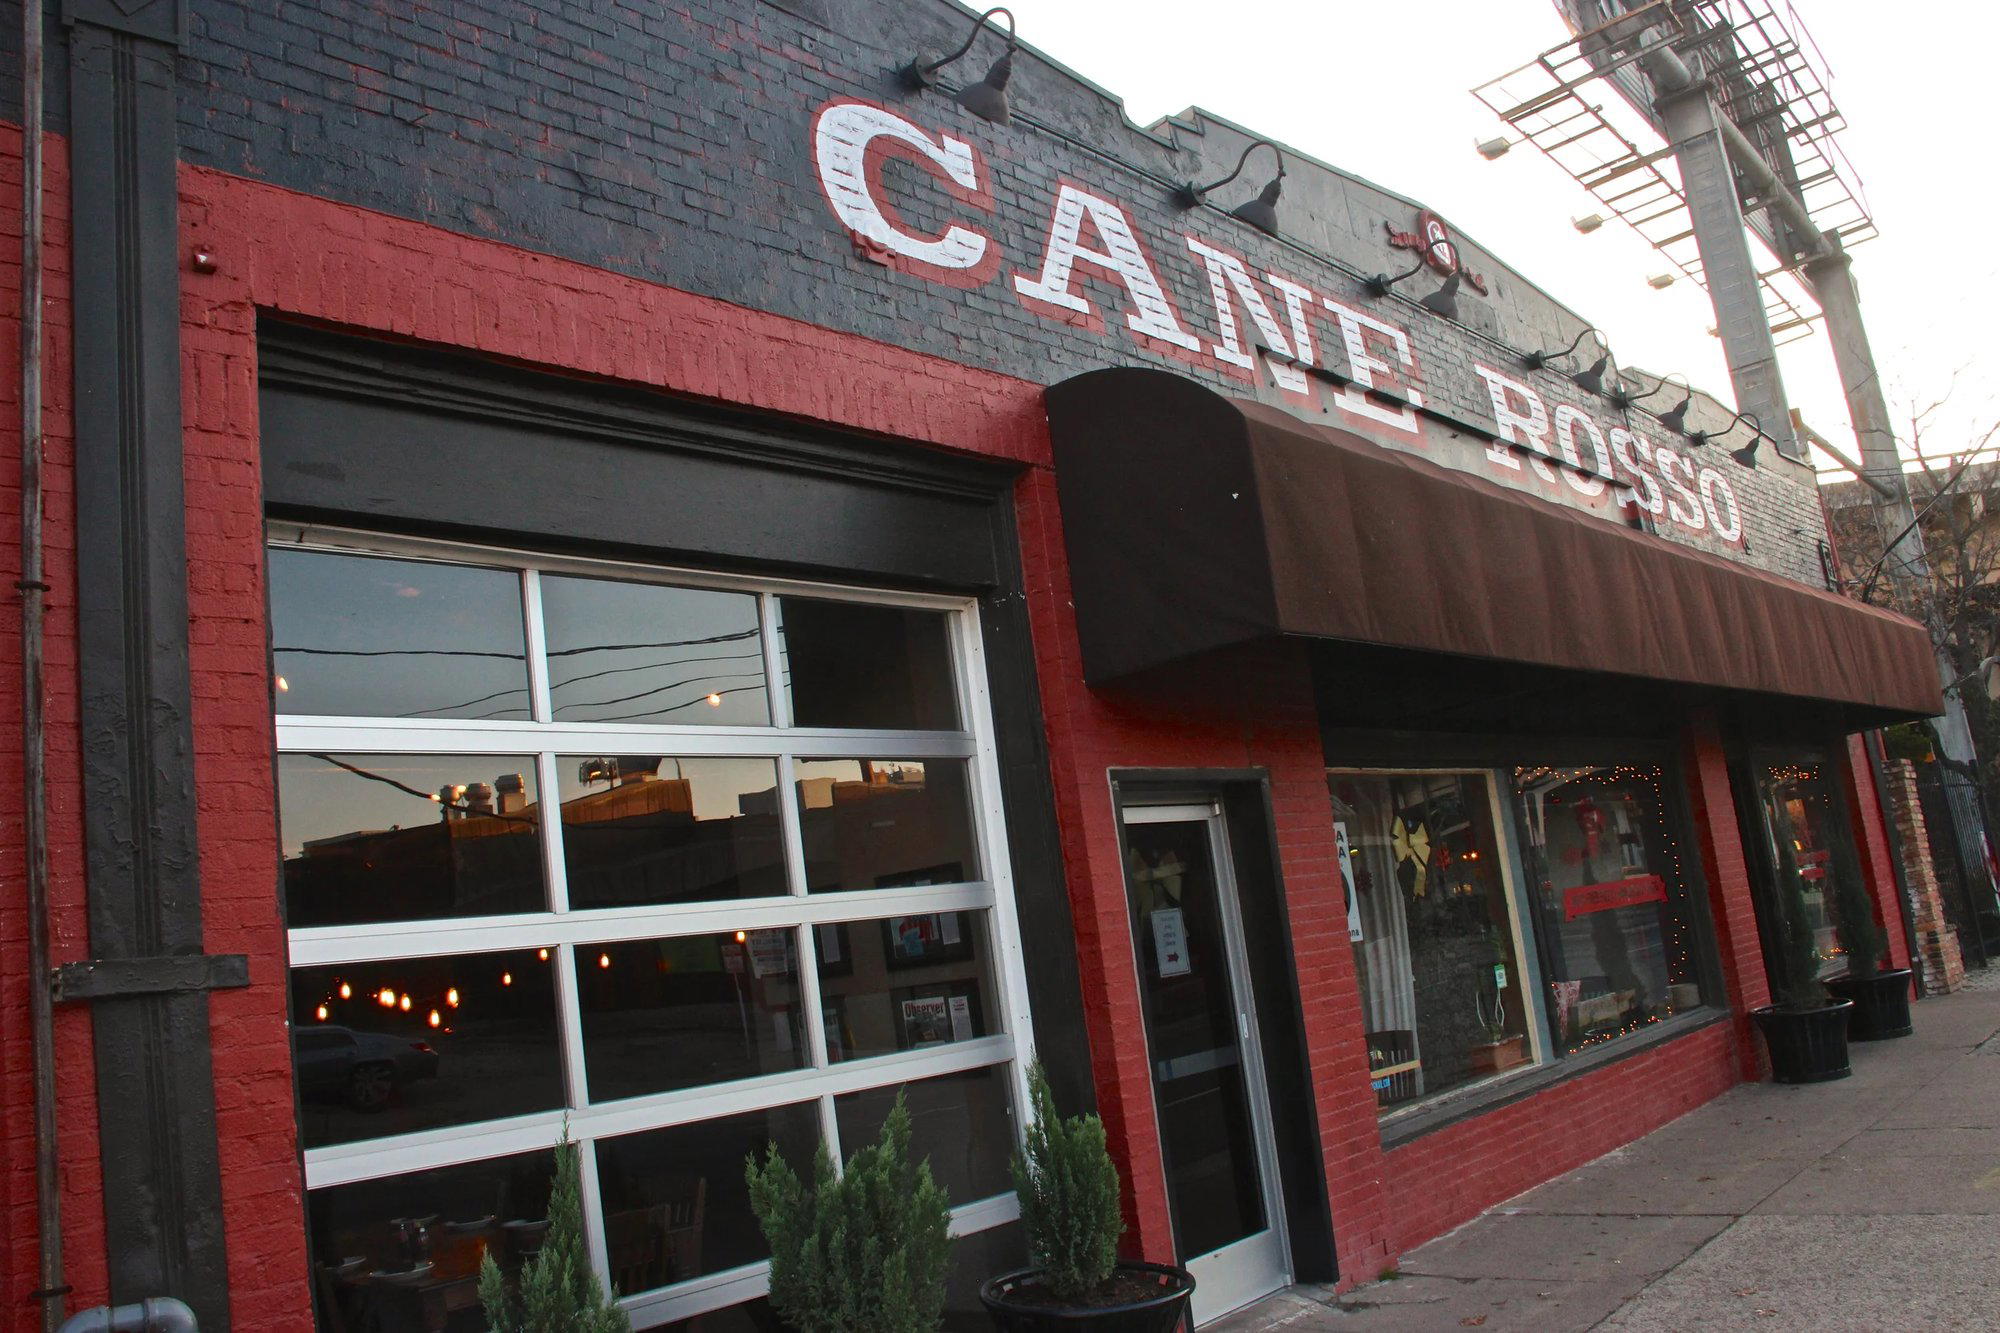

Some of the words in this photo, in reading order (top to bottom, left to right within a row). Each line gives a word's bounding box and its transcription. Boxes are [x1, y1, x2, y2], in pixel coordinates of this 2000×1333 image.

[815, 103, 1423, 433] CANE
[1473, 364, 1741, 542] ROSSO
[904, 1002, 944, 1018] Observer
